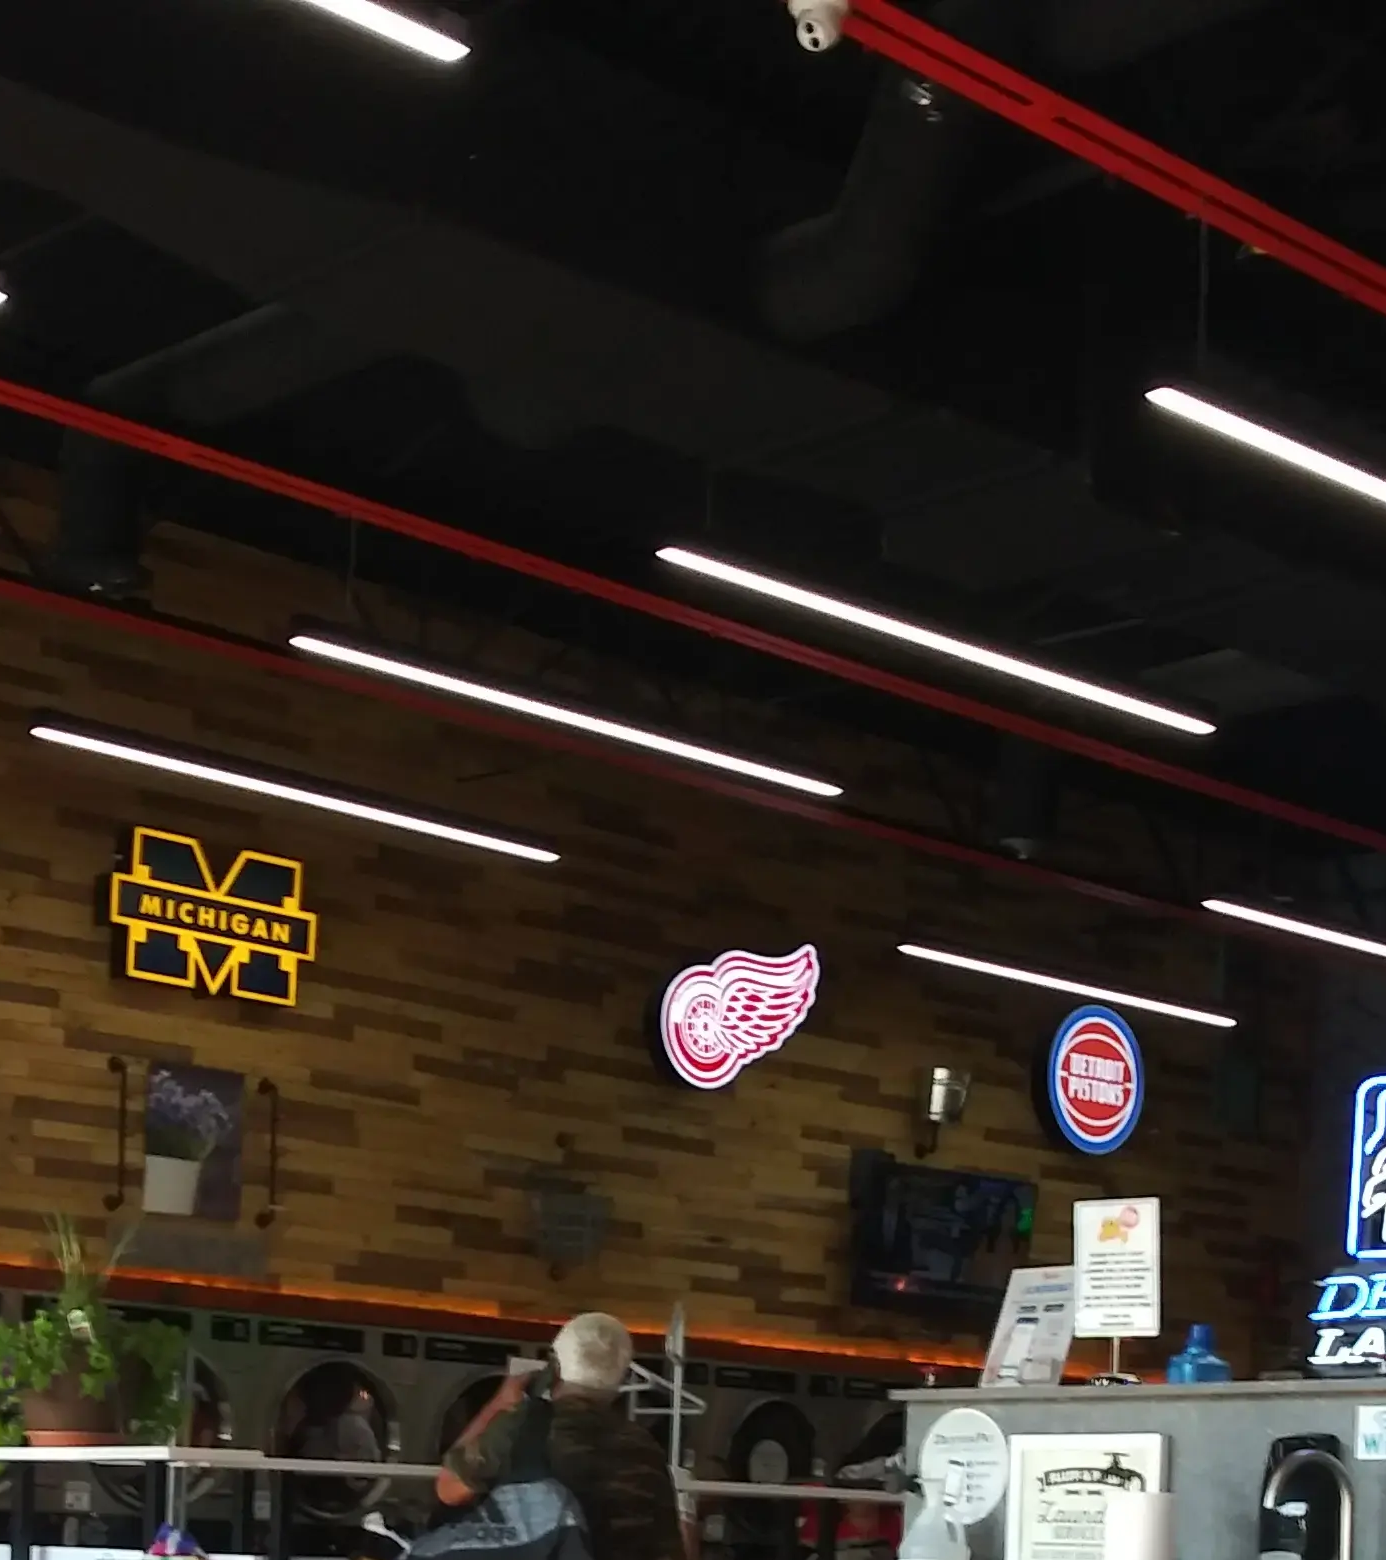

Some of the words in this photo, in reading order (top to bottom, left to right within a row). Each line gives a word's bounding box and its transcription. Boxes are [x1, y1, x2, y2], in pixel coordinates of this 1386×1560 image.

[138, 893, 291, 944] MICHIGAN
[1069, 1052, 1125, 1084] DETROIT
[1067, 1076, 1124, 1107] PISTONS
